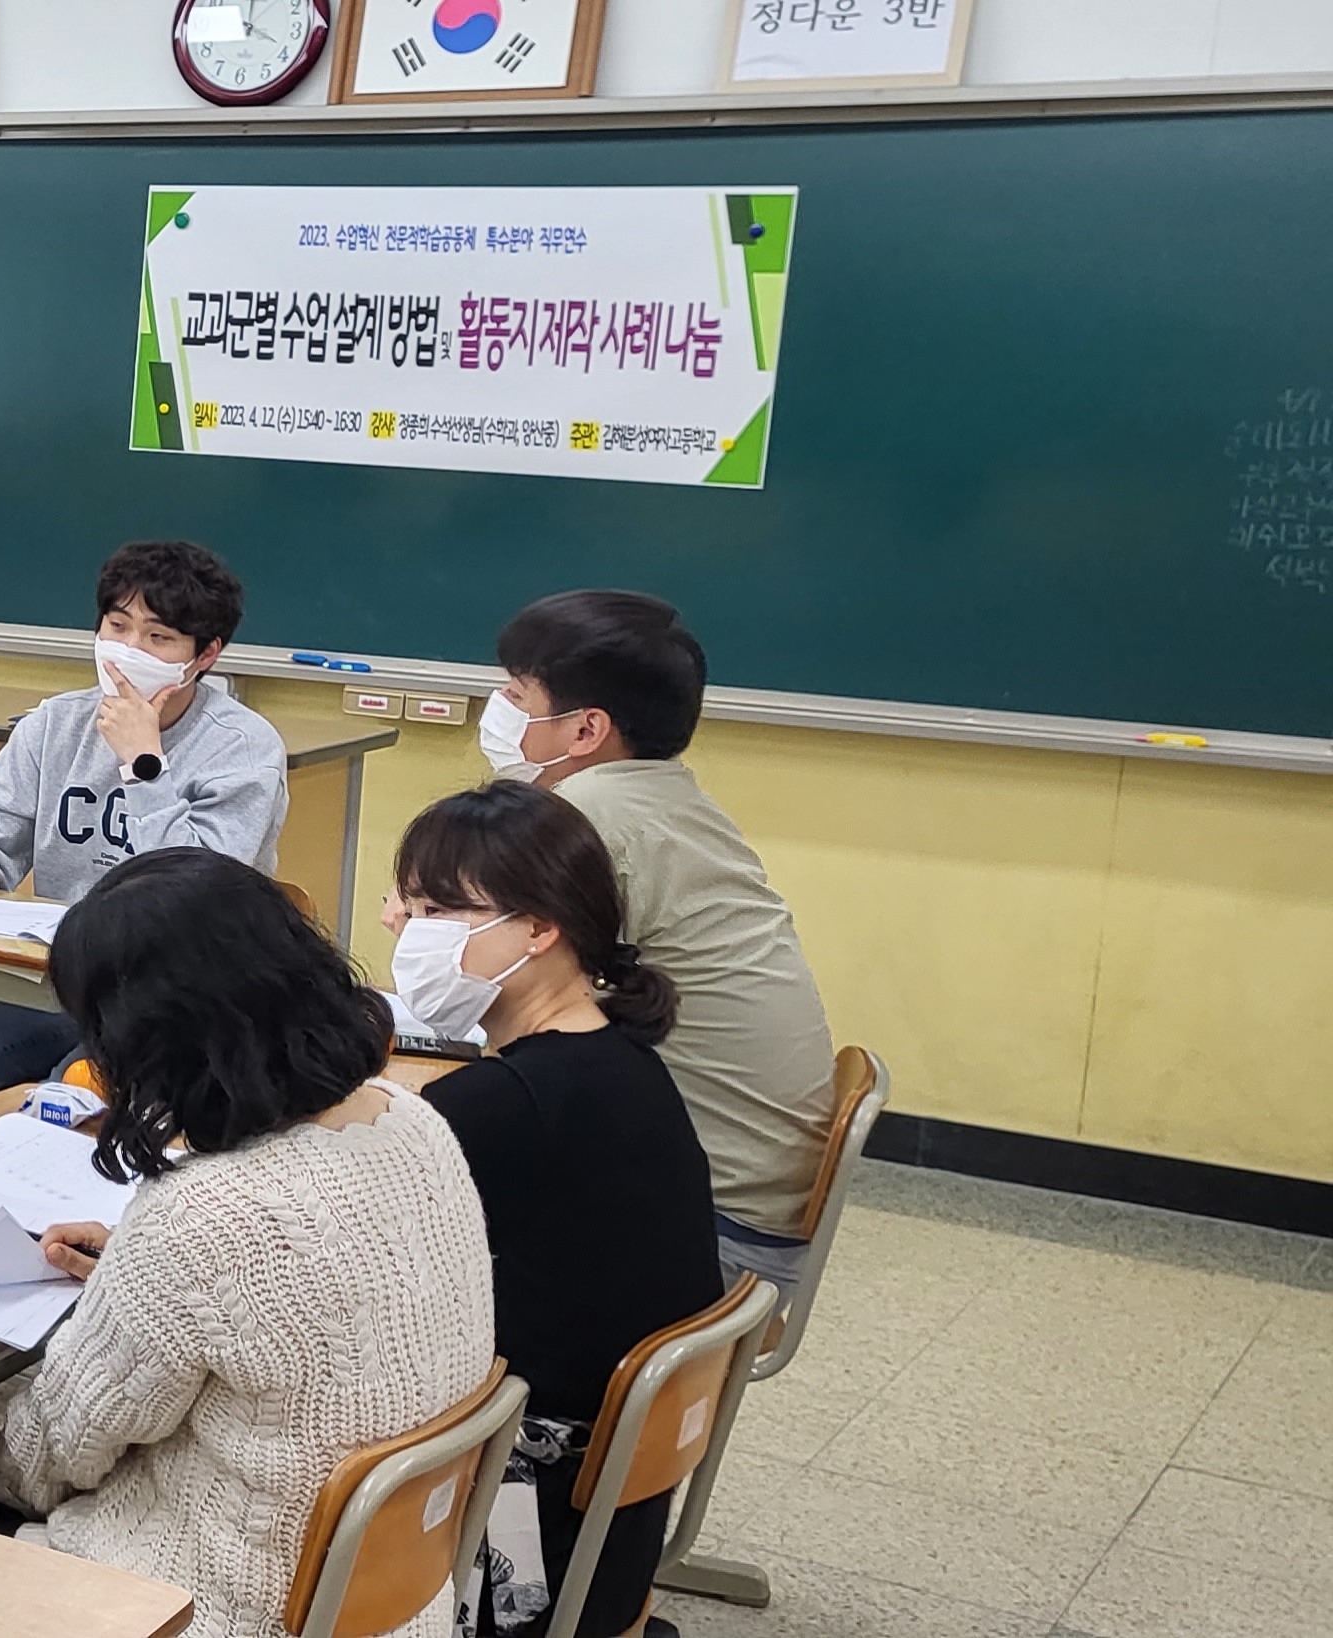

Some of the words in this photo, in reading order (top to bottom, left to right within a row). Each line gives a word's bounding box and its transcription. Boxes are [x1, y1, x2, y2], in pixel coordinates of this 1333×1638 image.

[751, 0, 862, 34] 정다운
[883, 0, 946, 28] 3반
[290, 22, 302, 40] 3
[200, 42, 213, 58] 8
[277, 45, 289, 63] 4
[214, 60, 226, 77] 7
[234, 67, 246, 86] 6
[260, 64, 272, 80] 5
[299, 224, 330, 247] 2023.
[335, 224, 381, 250] 수업혁신
[385, 224, 477, 253] 전문적학습공동체
[486, 226, 534, 254] 특수분야
[540, 226, 588, 254] 직무연수
[182, 291, 279, 360] 교과군별
[281, 291, 331, 363] 수업
[334, 293, 385, 364] 설계
[389, 295, 440, 367] 방법
[441, 331, 452, 360] 및
[458, 291, 538, 371] 활동지
[539, 299, 600, 373] 제작
[600, 301, 663, 370] 사례
[665, 302, 722, 378] 나눔
